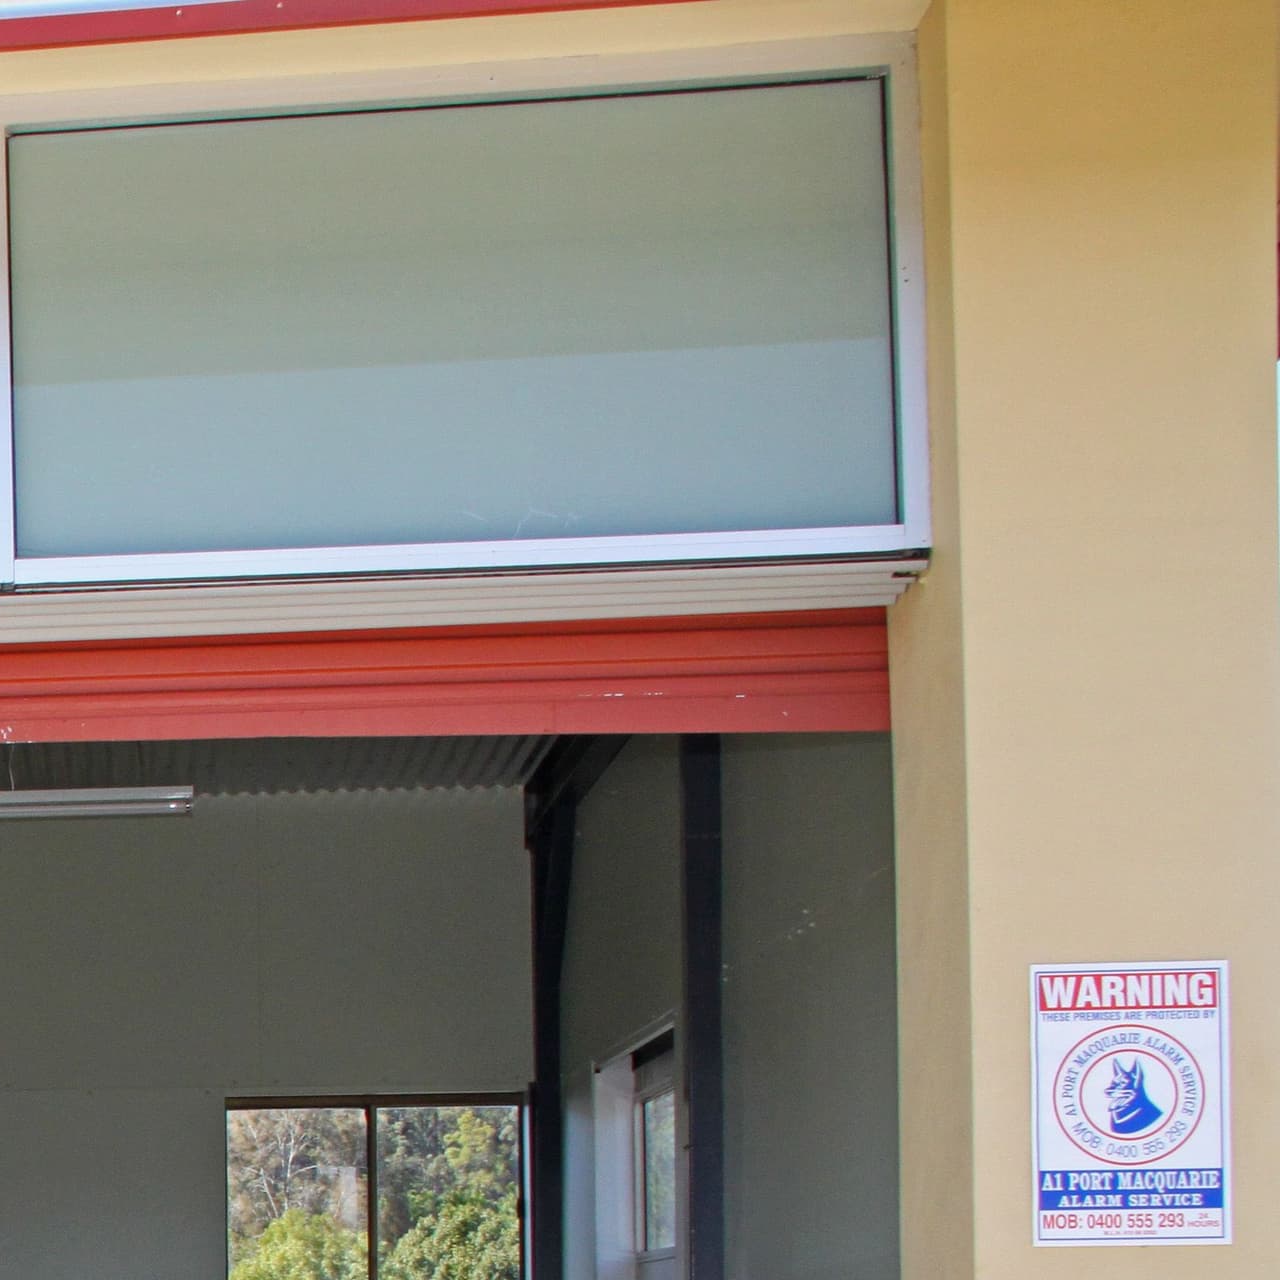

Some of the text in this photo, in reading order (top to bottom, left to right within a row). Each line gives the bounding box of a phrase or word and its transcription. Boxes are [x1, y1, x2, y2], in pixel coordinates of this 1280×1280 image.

[1041, 973, 1214, 1008] WARNING
[1042, 1010, 1215, 1022] THESE PREMISES ARE PROTECTED BY
[1062, 1066, 1080, 1099] PORT
[1072, 1032, 1141, 1068] MACQUARIE
[1142, 1036, 1184, 1066] ALARM
[1179, 1065, 1198, 1117] SERVICE
[1106, 1143, 1138, 1158] 0400
[1142, 1138, 1166, 1156] 555
[1164, 1120, 1188, 1143] 293
[1041, 1170, 1221, 1193] A1 PORT MACQUARIE
[1058, 1193, 1203, 1207] ALARM SERVICE
[1042, 1212, 1185, 1229] MOB: 0400 555 293
[1187, 1220, 1220, 1228] HOURS
